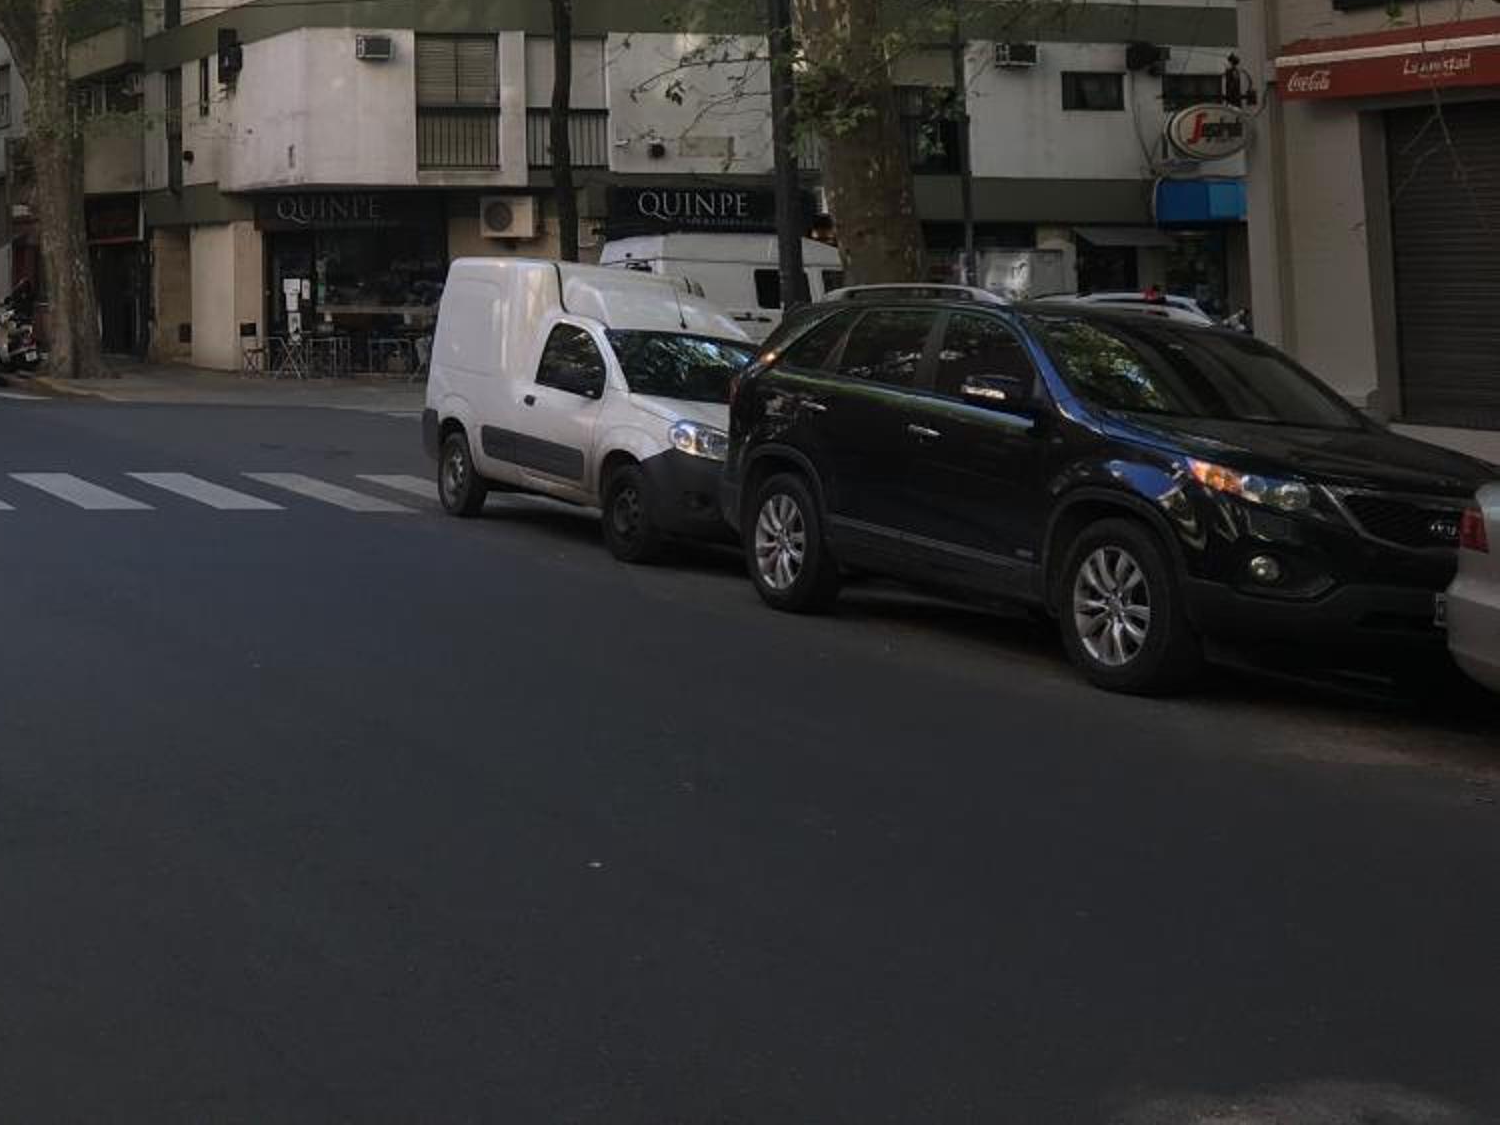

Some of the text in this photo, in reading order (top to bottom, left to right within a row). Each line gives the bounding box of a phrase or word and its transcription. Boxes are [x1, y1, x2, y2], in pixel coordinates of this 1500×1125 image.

[1287, 70, 1332, 92] Coca-Cola
[276, 195, 381, 224] QUINPE
[637, 191, 749, 221] QUINPE
